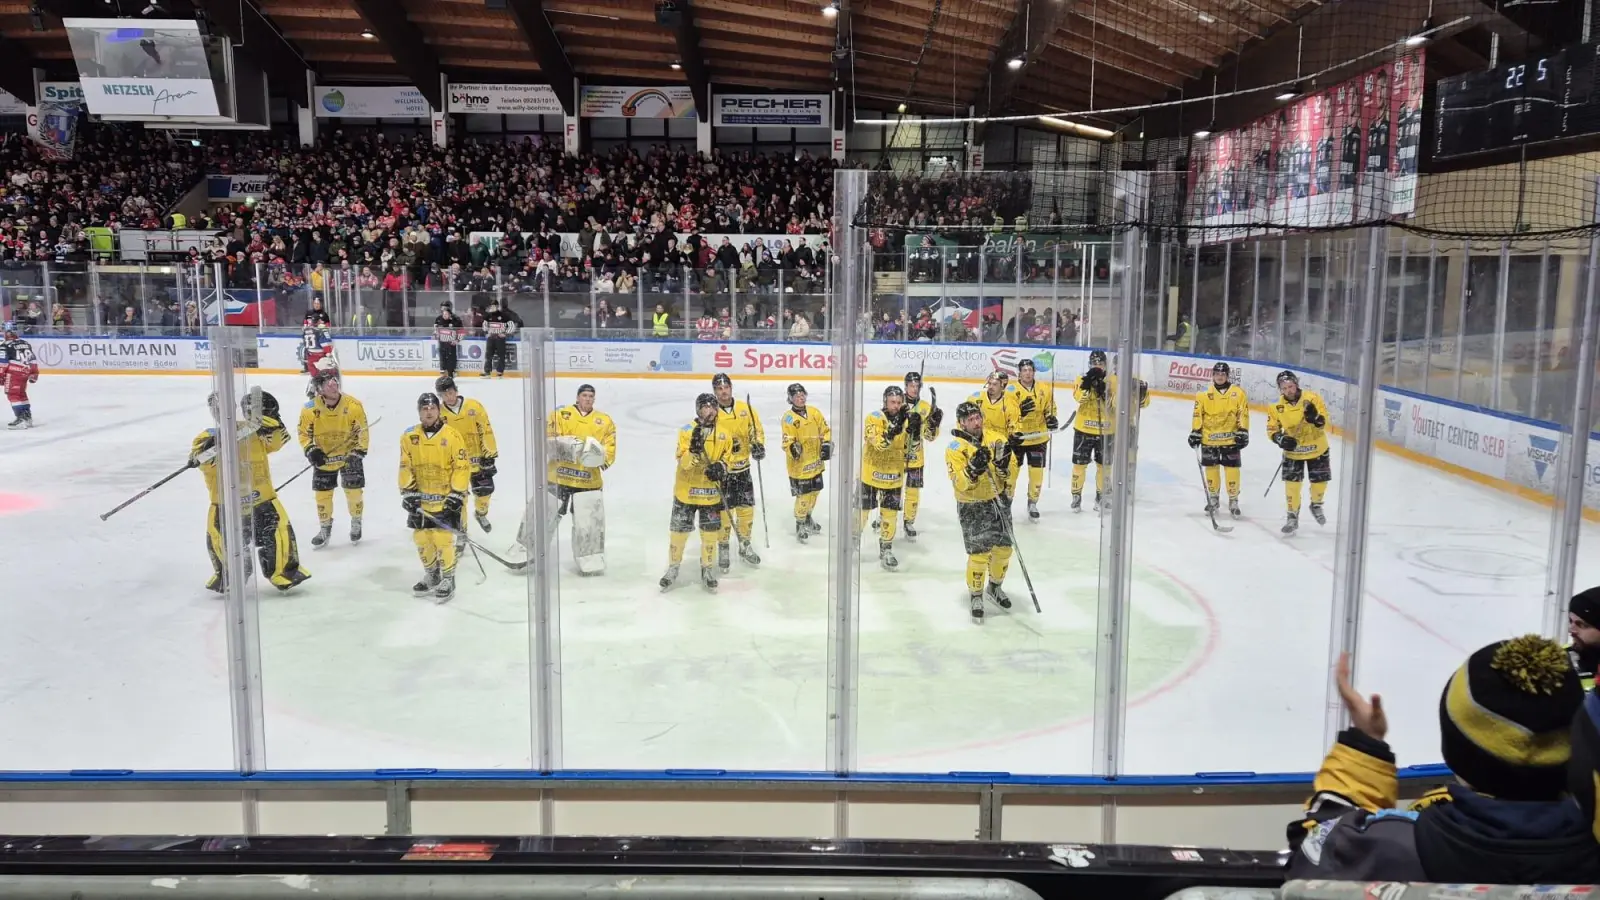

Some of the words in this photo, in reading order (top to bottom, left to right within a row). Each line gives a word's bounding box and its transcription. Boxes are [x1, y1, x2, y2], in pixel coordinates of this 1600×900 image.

[103, 84, 154, 96] NETZSCH
[451, 92, 490, 104] böhme
[721, 98, 822, 109] PECHER
[434, 120, 443, 132] F
[566, 124, 575, 136] F
[833, 138, 843, 151] E
[68, 340, 177, 356] PÖHLMANN
[358, 346, 423, 360] MÜSSEL
[893, 347, 988, 361] Kabelkonfektion
[743, 348, 868, 373] Sparkase
[1447, 425, 1480, 451] CENTER
[1482, 435, 1505, 458] SELB
[1526, 447, 1559, 465] VISHAY
